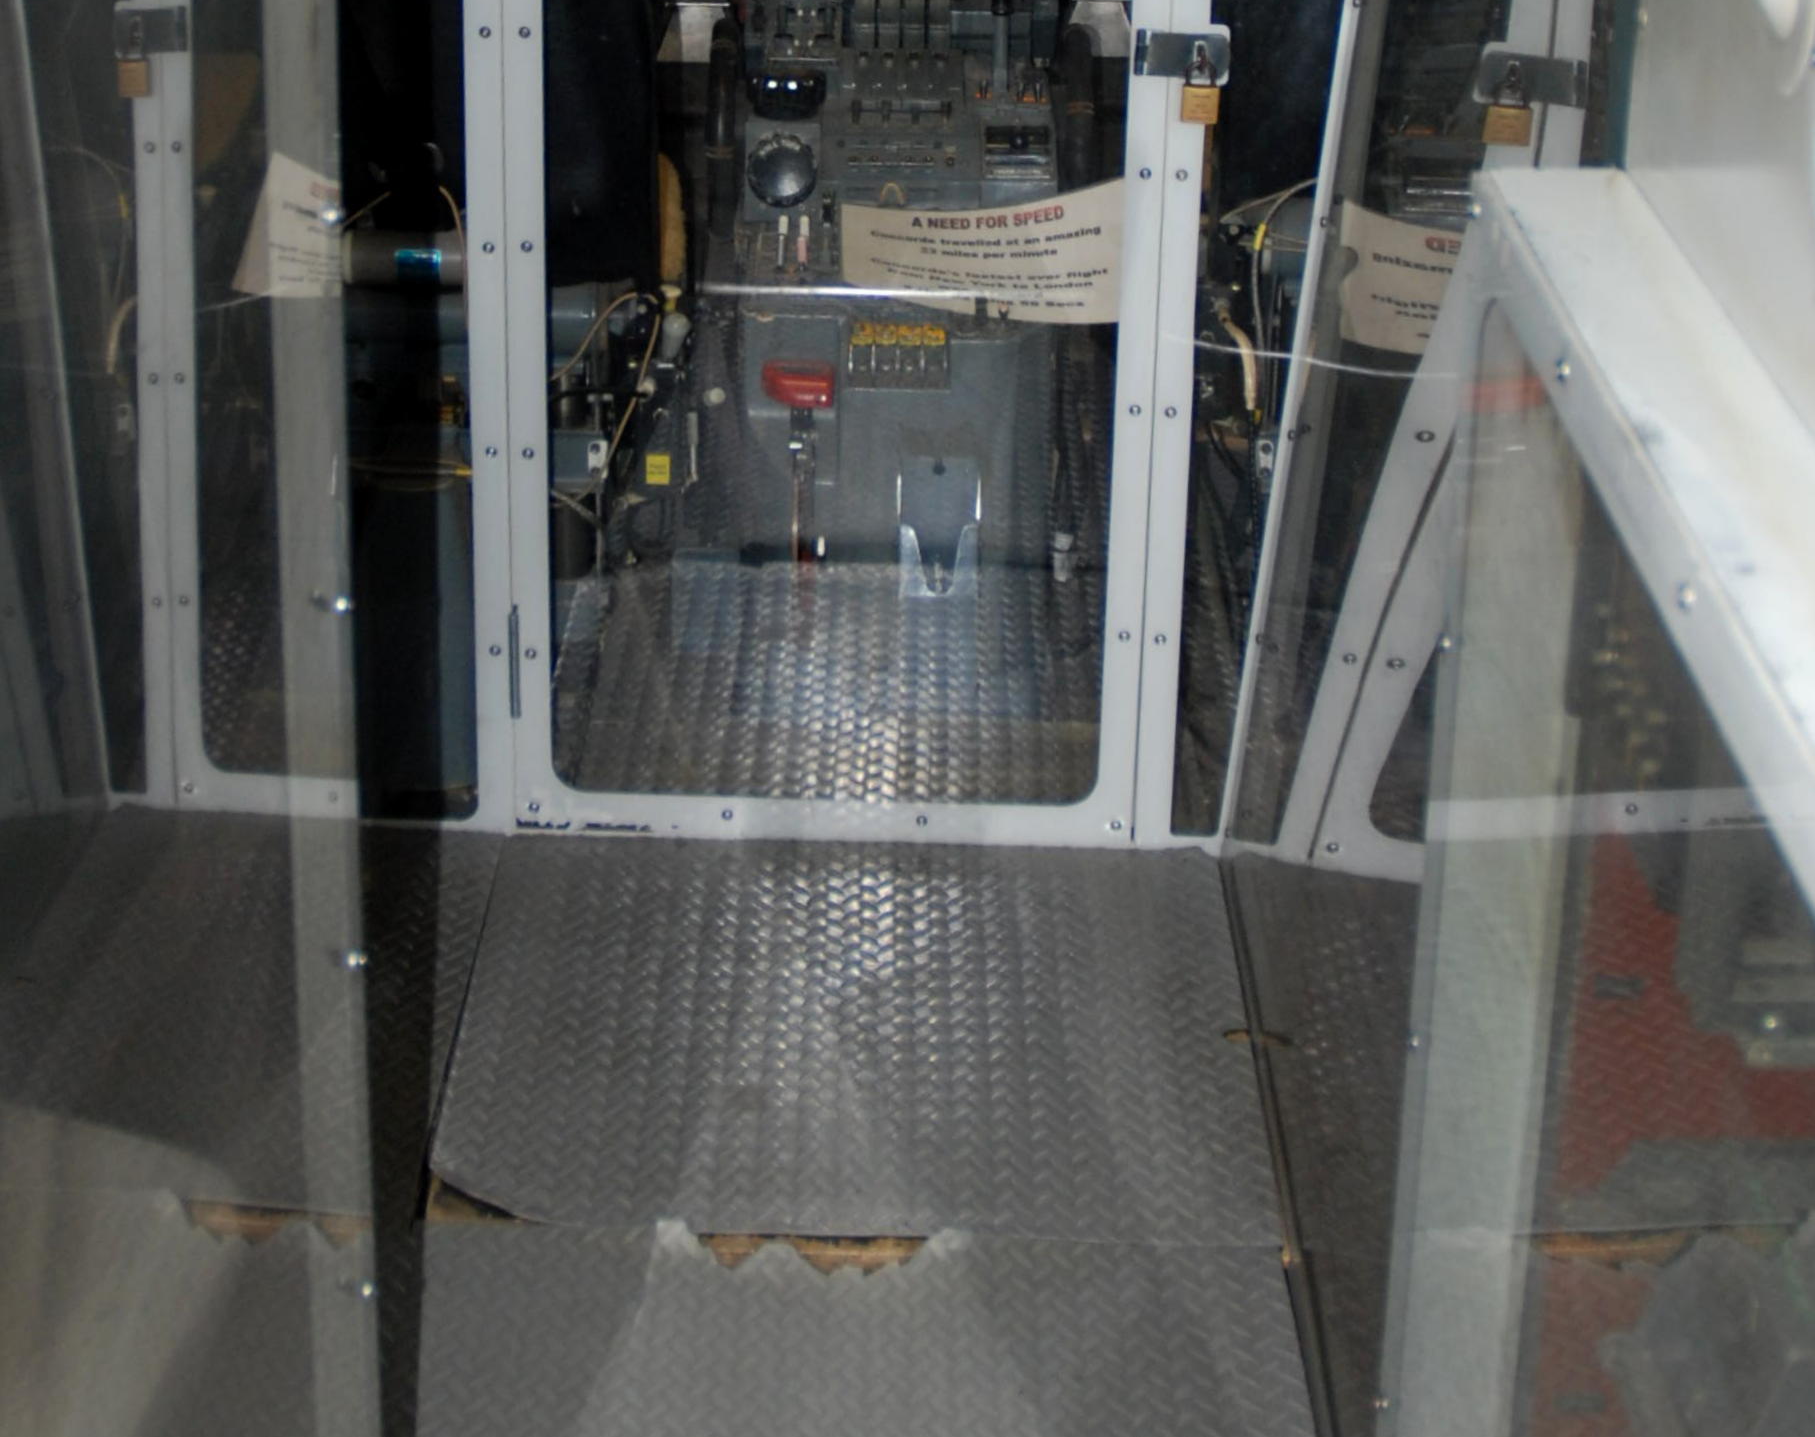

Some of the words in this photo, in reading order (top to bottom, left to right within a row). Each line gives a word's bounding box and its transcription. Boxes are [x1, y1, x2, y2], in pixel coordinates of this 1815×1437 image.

[911, 217, 923, 228] A
[927, 217, 971, 230] NEED
[976, 214, 1008, 229] FOR
[1013, 205, 1064, 227] SPEED
[940, 237, 1001, 247] travelled
[1006, 238, 1019, 246] at
[1024, 236, 1040, 245] an
[1045, 225, 1102, 243] amazing
[941, 248, 979, 258] miles
[982, 251, 1005, 260] per
[1010, 248, 1058, 259] minute
[1066, 267, 1109, 280] flight
[1034, 280, 1094, 290] London
